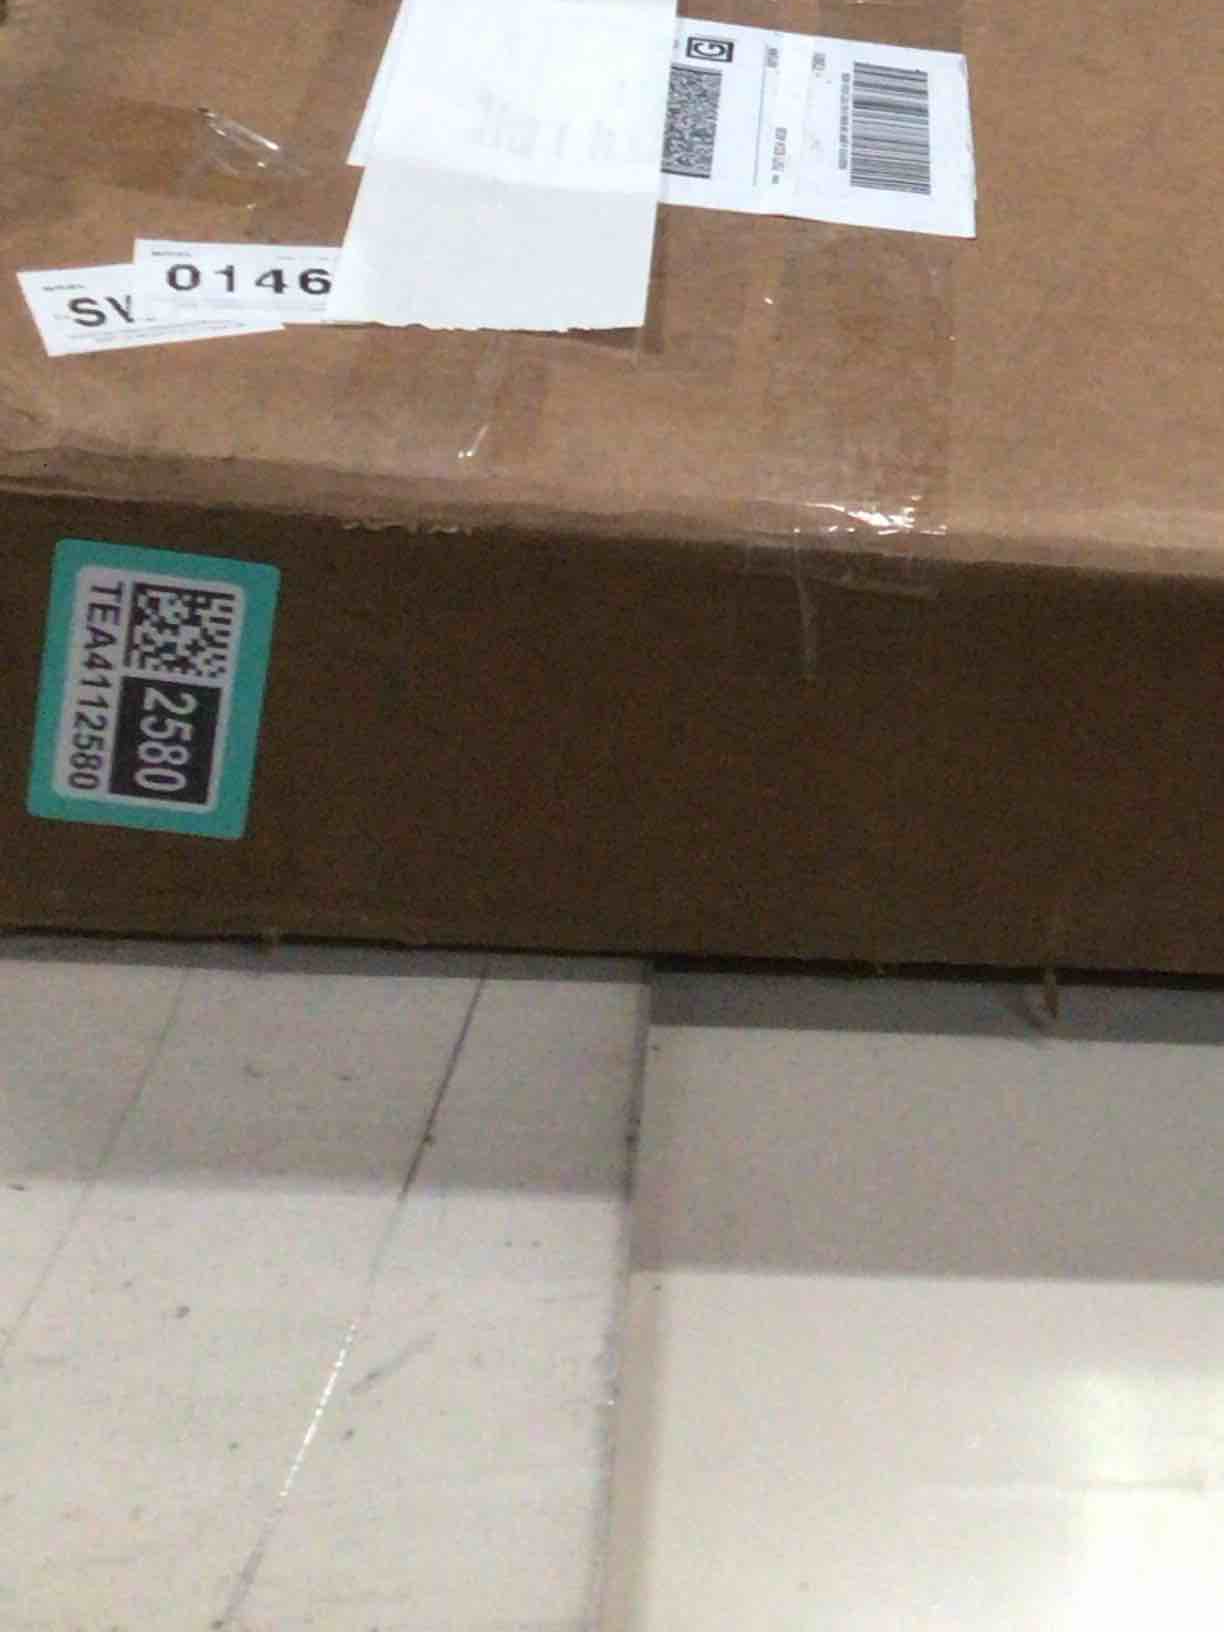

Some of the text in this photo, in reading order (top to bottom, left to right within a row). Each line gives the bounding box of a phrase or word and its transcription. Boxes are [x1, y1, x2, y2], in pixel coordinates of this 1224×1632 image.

[166, 263, 333, 296] 0146
[67, 579, 127, 792] TEA4112580
[133, 686, 198, 795] 2580
